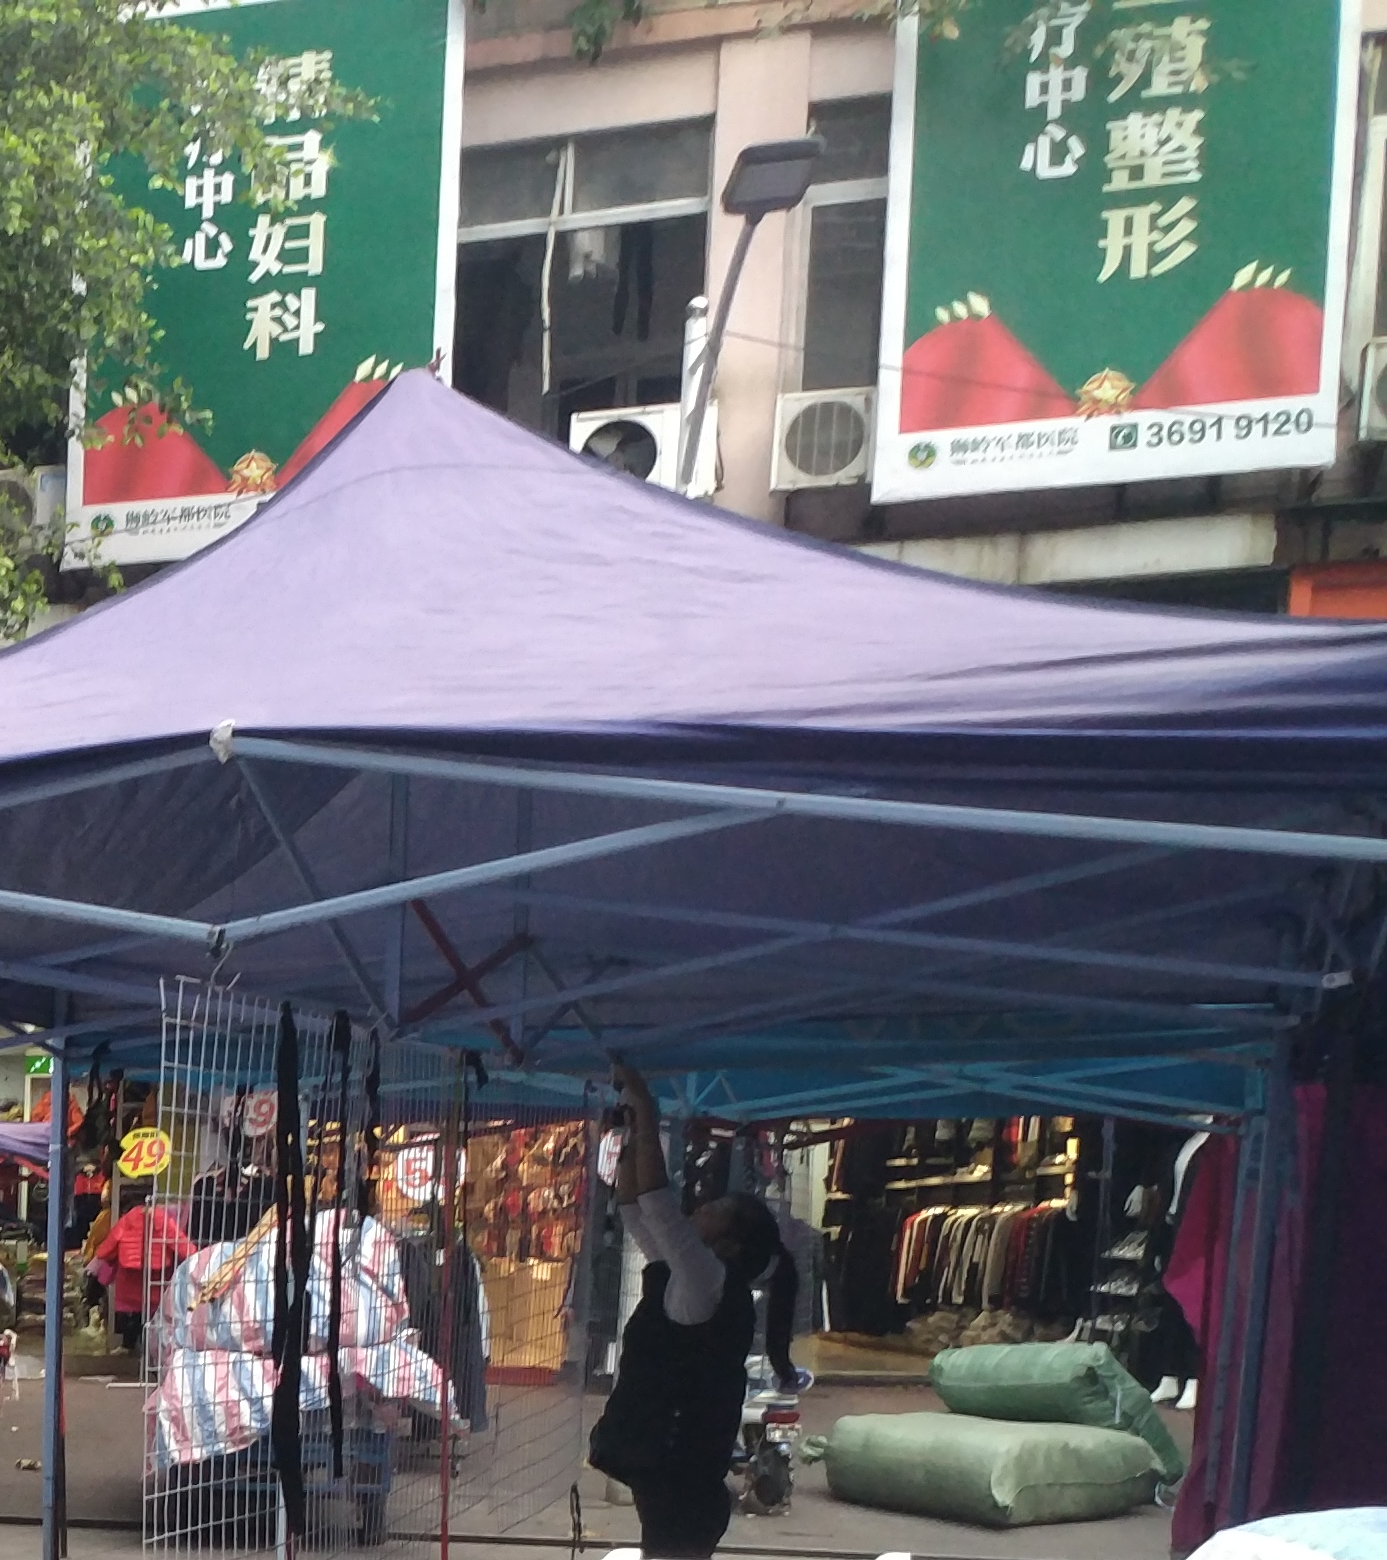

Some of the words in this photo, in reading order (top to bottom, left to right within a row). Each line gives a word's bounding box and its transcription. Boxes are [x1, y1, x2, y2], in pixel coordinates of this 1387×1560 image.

[1096, 0, 1212, 284] 殖整形
[121, 1139, 166, 1172] 49
